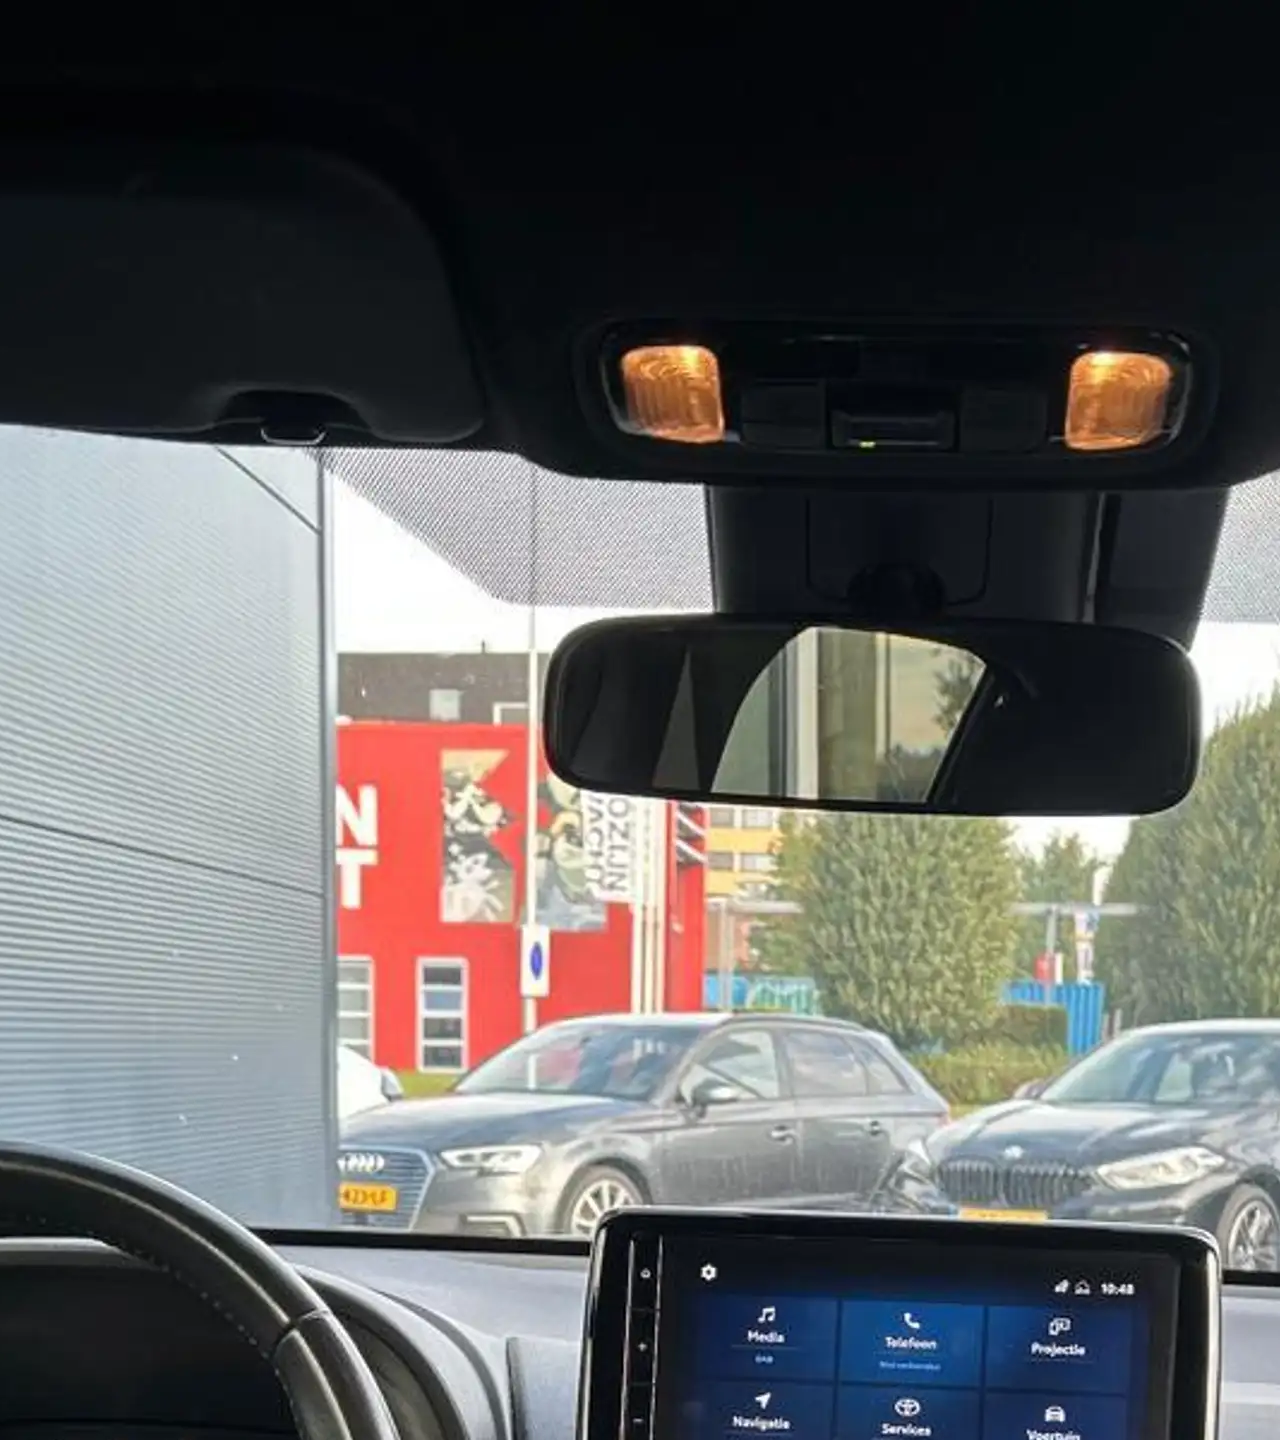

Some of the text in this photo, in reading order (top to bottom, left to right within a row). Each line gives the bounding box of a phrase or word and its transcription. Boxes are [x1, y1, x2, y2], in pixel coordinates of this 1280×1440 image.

[746, 1330, 785, 1344] Media
[885, 1336, 938, 1351] Telefoon
[1030, 1342, 1086, 1357] Projectie
[732, 1414, 791, 1432] Navigatie
[880, 1423, 933, 1437] Services
